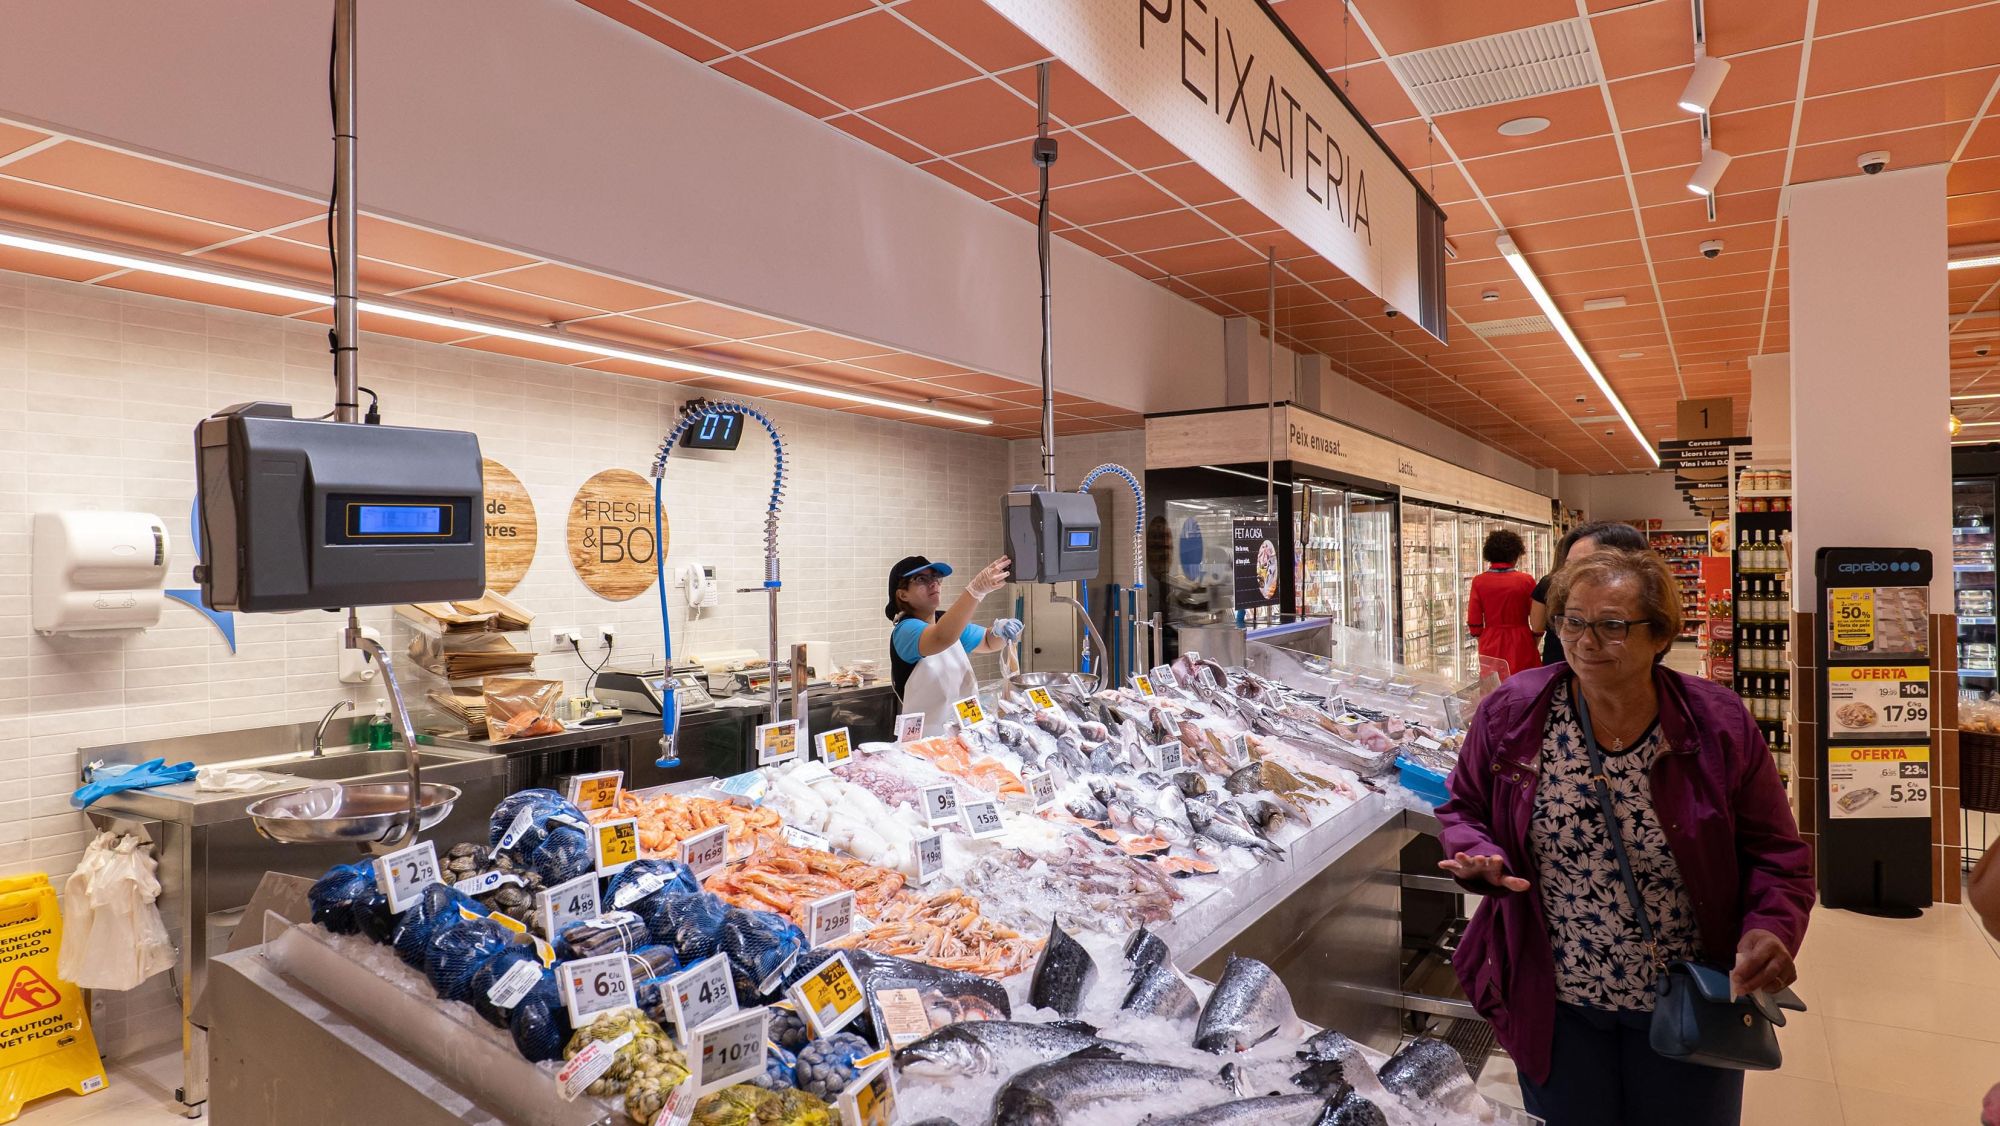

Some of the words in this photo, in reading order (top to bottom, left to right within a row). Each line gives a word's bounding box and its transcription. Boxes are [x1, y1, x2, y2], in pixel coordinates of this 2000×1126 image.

[700, 413, 734, 440] 07
[1700, 408, 1708, 428] 1
[1290, 424, 1309, 447] Peix
[486, 500, 506, 514] de
[585, 500, 651, 523] FRESH
[1234, 528, 1244, 538] FET
[1250, 528, 1264, 538] CASA
[1838, 561, 1888, 574] caprabo
[1837, 607, 1870, 618] -50%
[1851, 668, 1907, 679] OFERTA
[1902, 684, 1926, 694] -10%
[1884, 706, 1927, 722] 17,99
[1851, 749, 1907, 760] OFERTA
[1901, 765, 1926, 775] -23%
[1890, 785, 1927, 803] 5,29
[407, 862, 433, 884] 2,79
[568, 895, 594, 916] 4,89
[0, 947, 50, 964] OJADO
[594, 972, 625, 996] 6,20
[699, 980, 726, 1004] 4,35
[834, 982, 857, 1000] 5,95
[0, 1014, 63, 1037] CAUTION
[27, 1022, 73, 1041] FLOOR
[719, 1040, 760, 1064] 10,70
